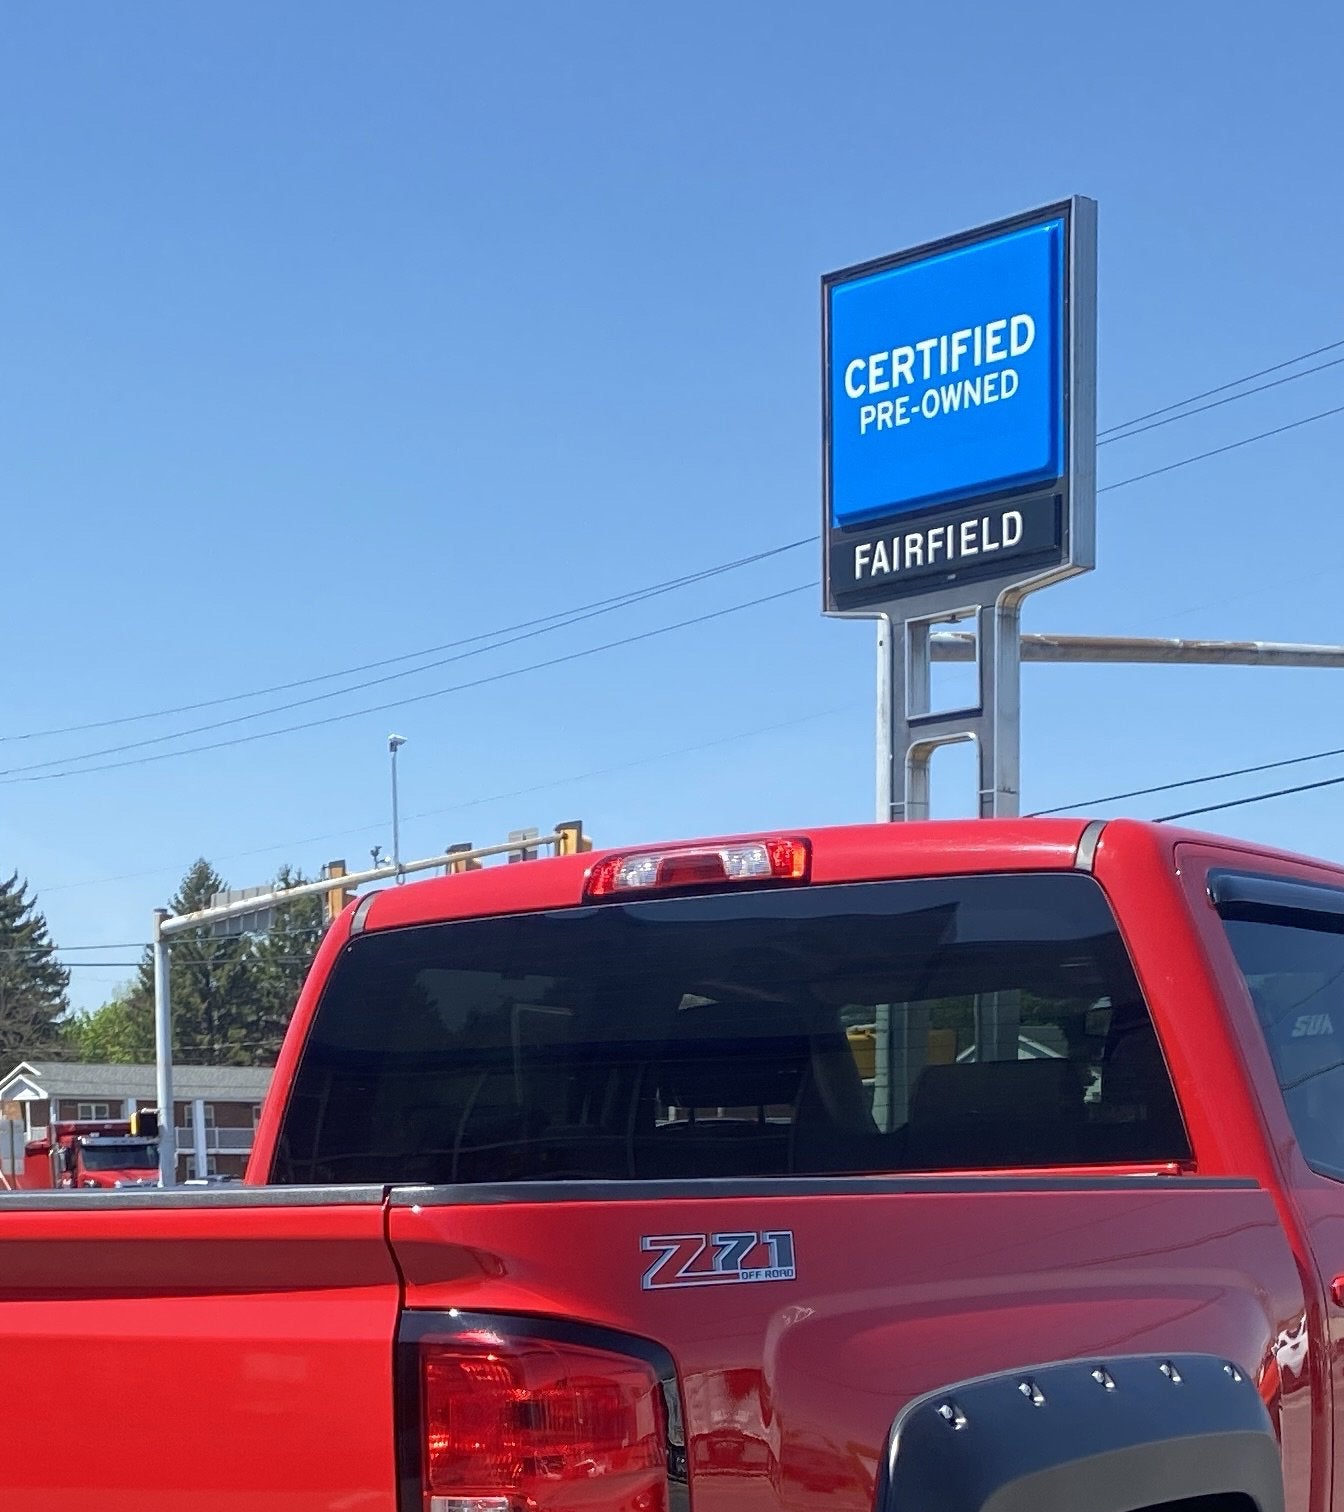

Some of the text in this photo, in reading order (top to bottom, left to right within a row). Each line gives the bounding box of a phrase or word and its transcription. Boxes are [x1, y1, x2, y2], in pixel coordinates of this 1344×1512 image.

[844, 313, 1036, 399] CERTIFIED
[860, 369, 1019, 435] PRE-OWNED
[854, 511, 1024, 580] FAIRFIELD
[640, 1231, 796, 1290] Z71
[741, 1268, 794, 1280] OFF ROAD
